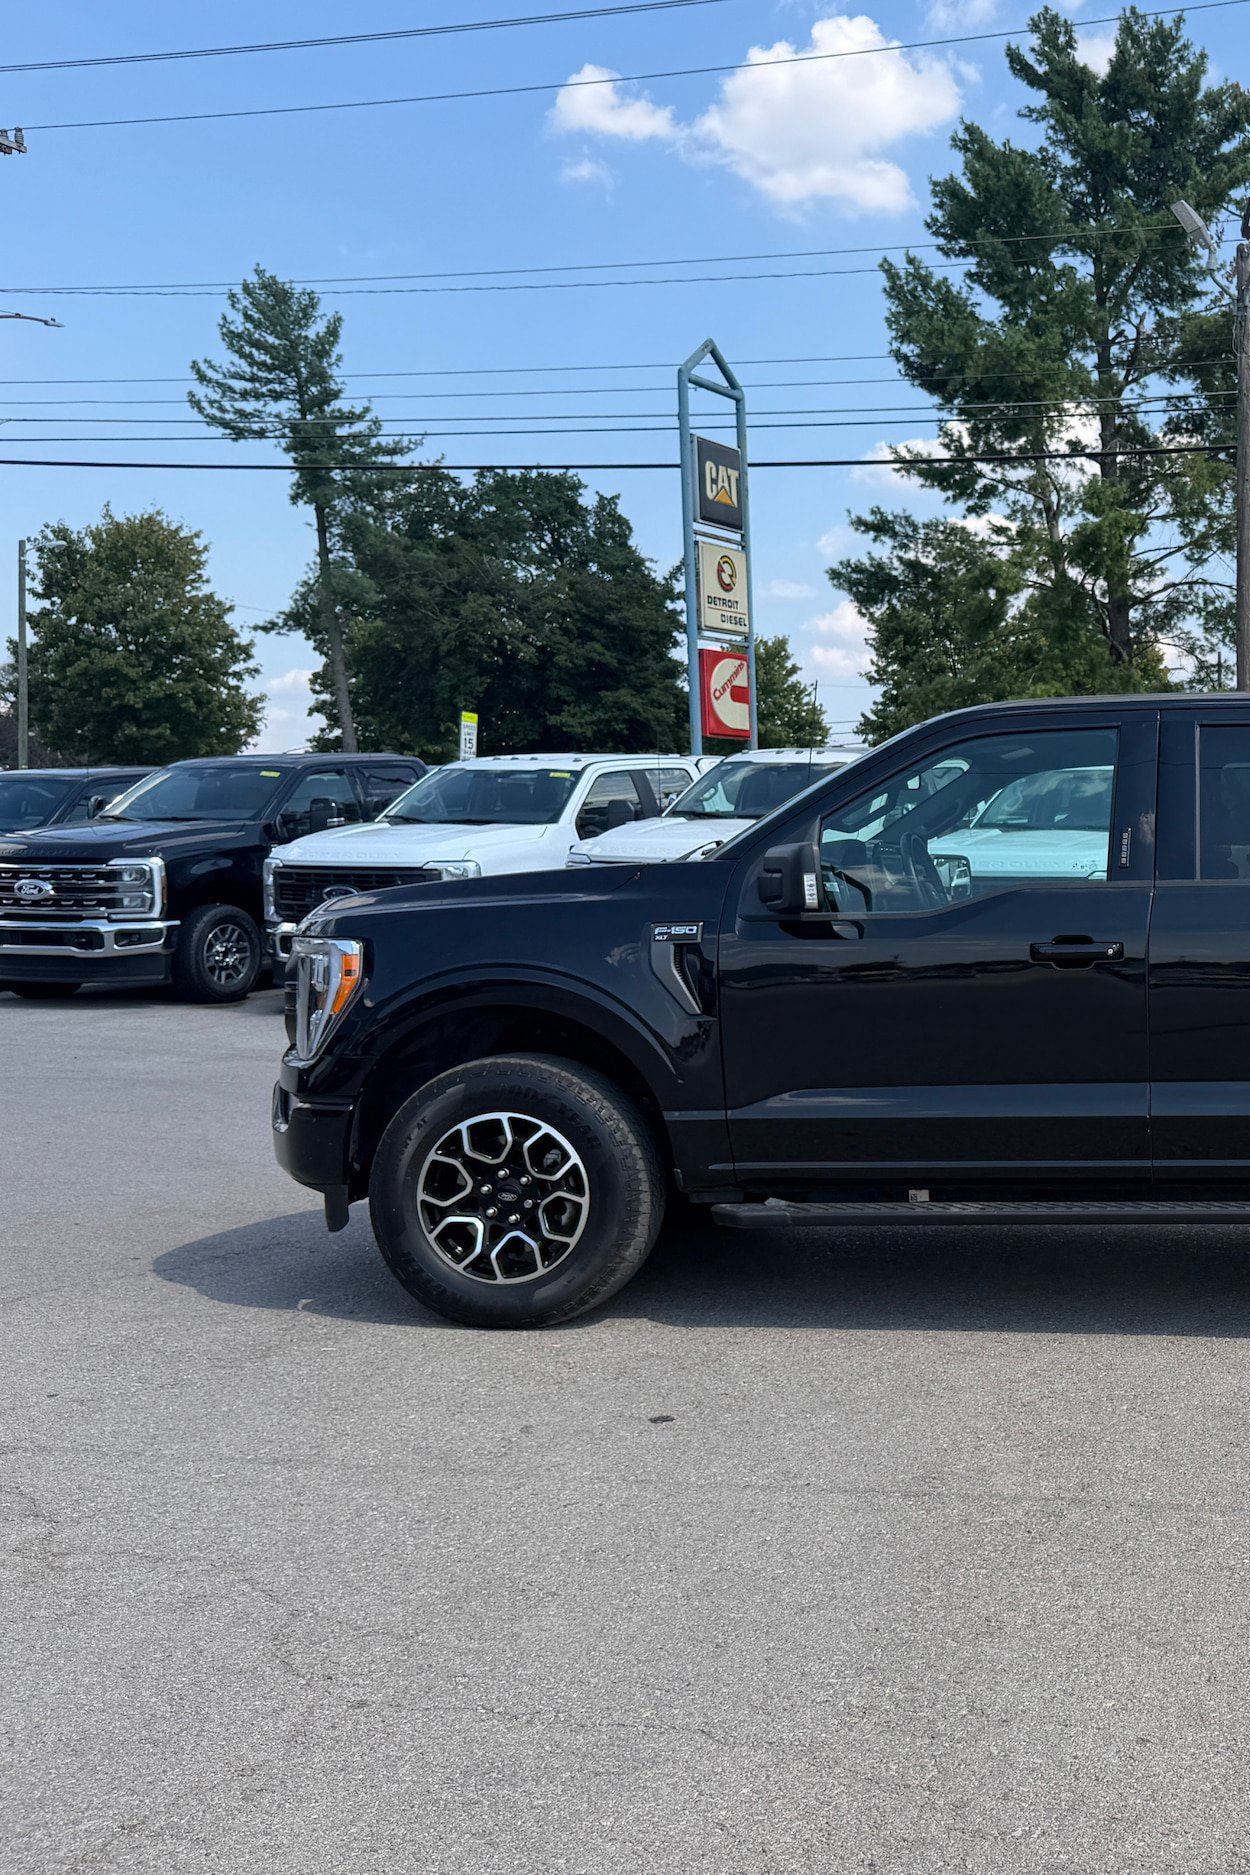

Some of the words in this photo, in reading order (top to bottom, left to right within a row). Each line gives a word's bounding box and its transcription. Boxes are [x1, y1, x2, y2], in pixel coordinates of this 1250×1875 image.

[705, 460, 739, 508] CAT
[707, 595, 739, 610] DETROIT
[721, 613, 747, 627] DIESEL
[713, 662, 745, 701] Cummins
[464, 738, 474, 749] 15
[21, 885, 39, 894] Ford
[654, 925, 697, 934] F-150
